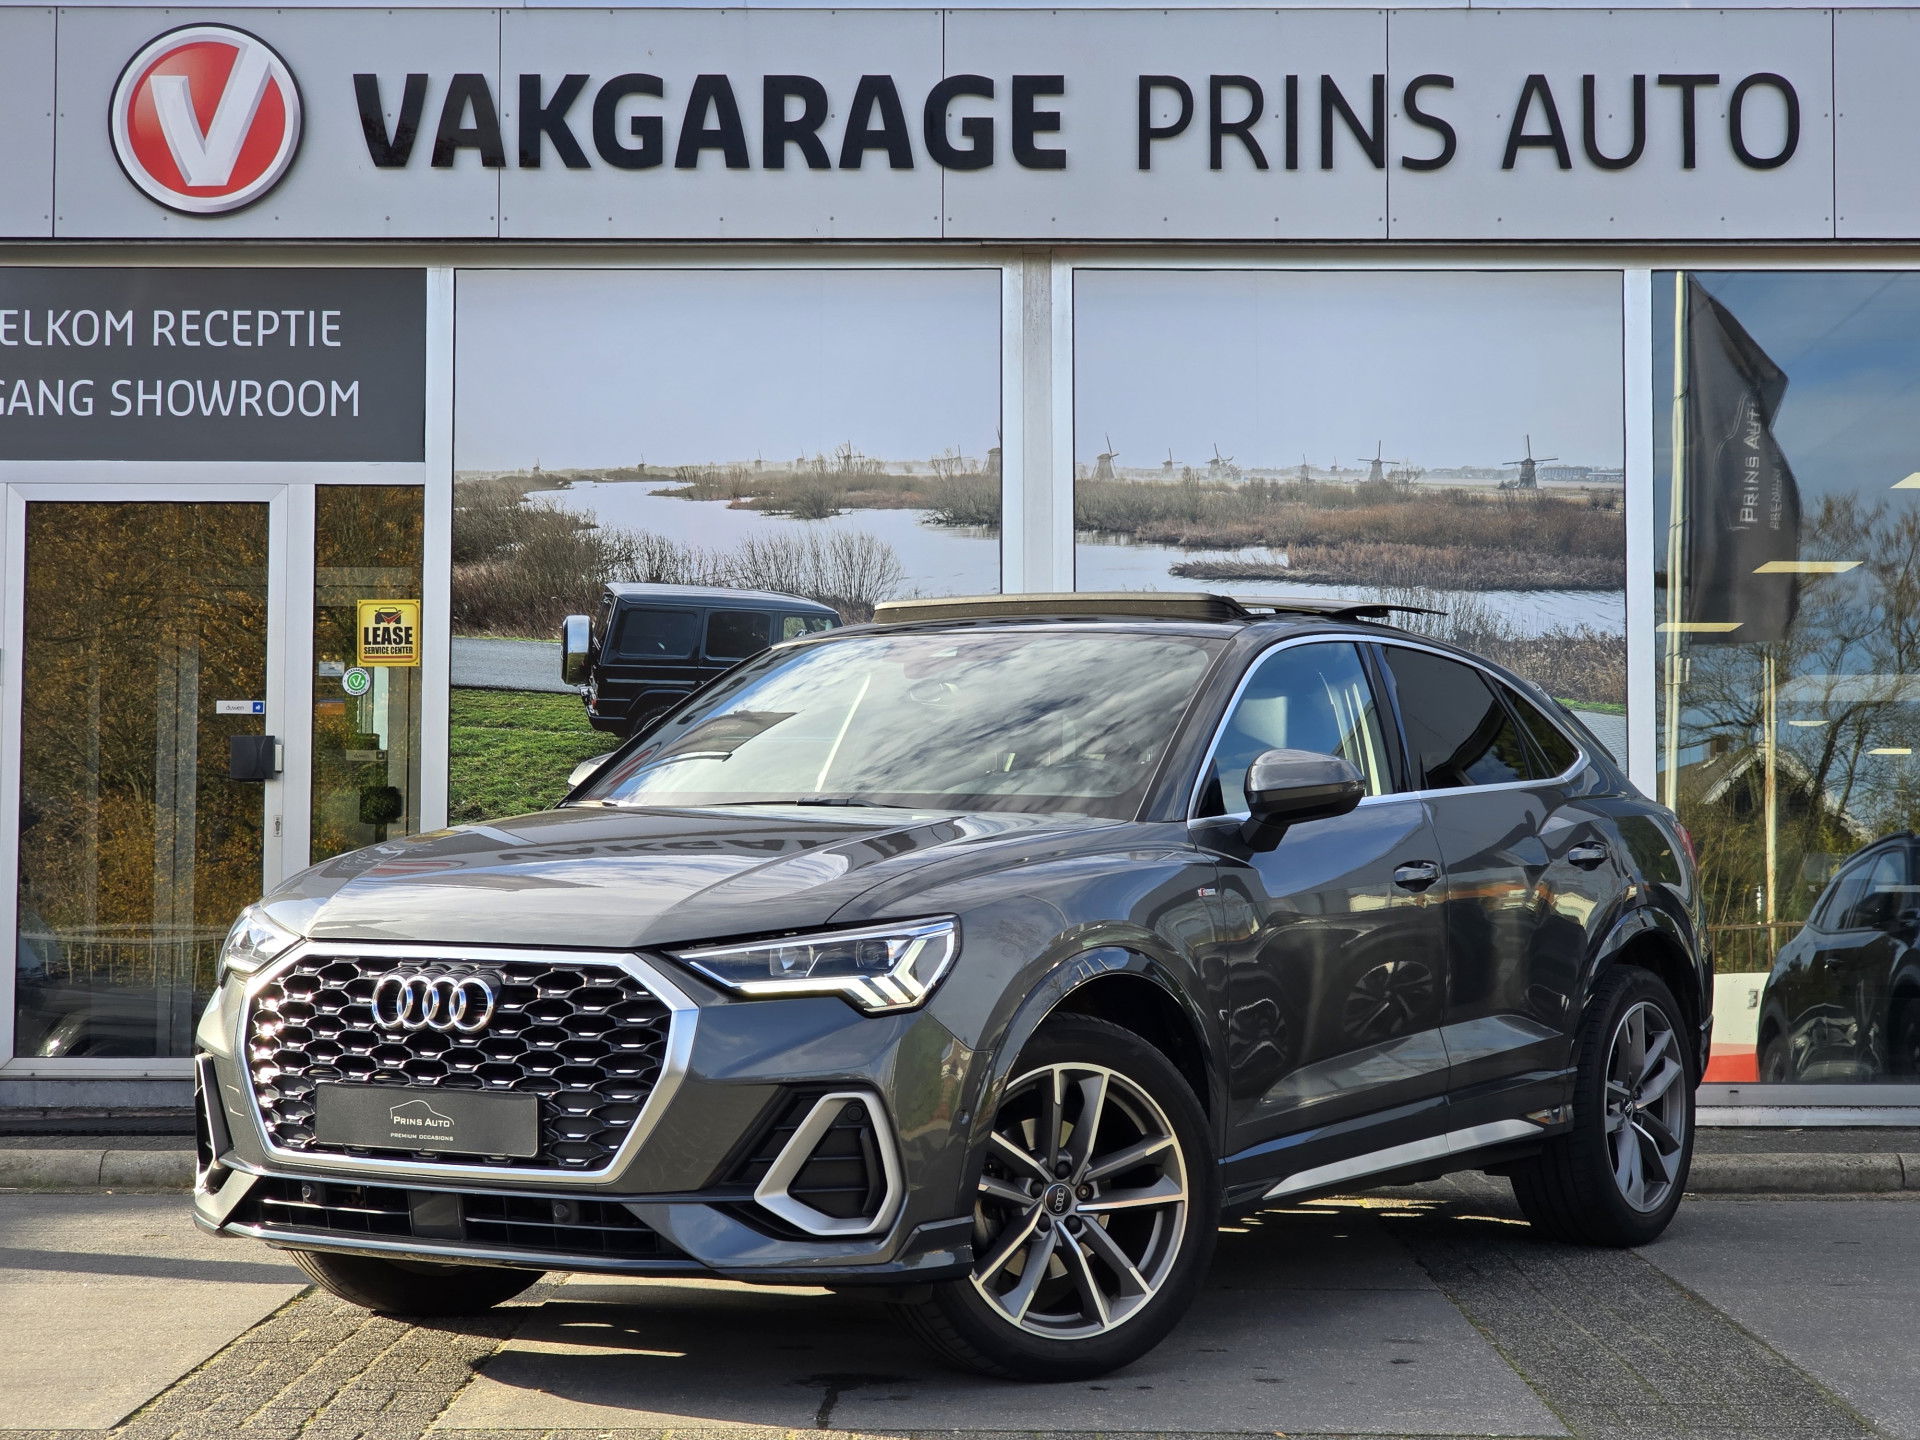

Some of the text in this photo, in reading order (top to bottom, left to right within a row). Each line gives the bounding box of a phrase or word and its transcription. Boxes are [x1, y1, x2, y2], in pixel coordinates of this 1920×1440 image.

[352, 72, 1801, 170] VAKGARAGE PRINS AUTO
[153, 309, 342, 347] RECEPTIE
[110, 379, 359, 417] SHOWROOM
[1743, 400, 1762, 451] AUT
[364, 626, 413, 645] LEASE
[364, 646, 413, 655] SERVICE CENTER
